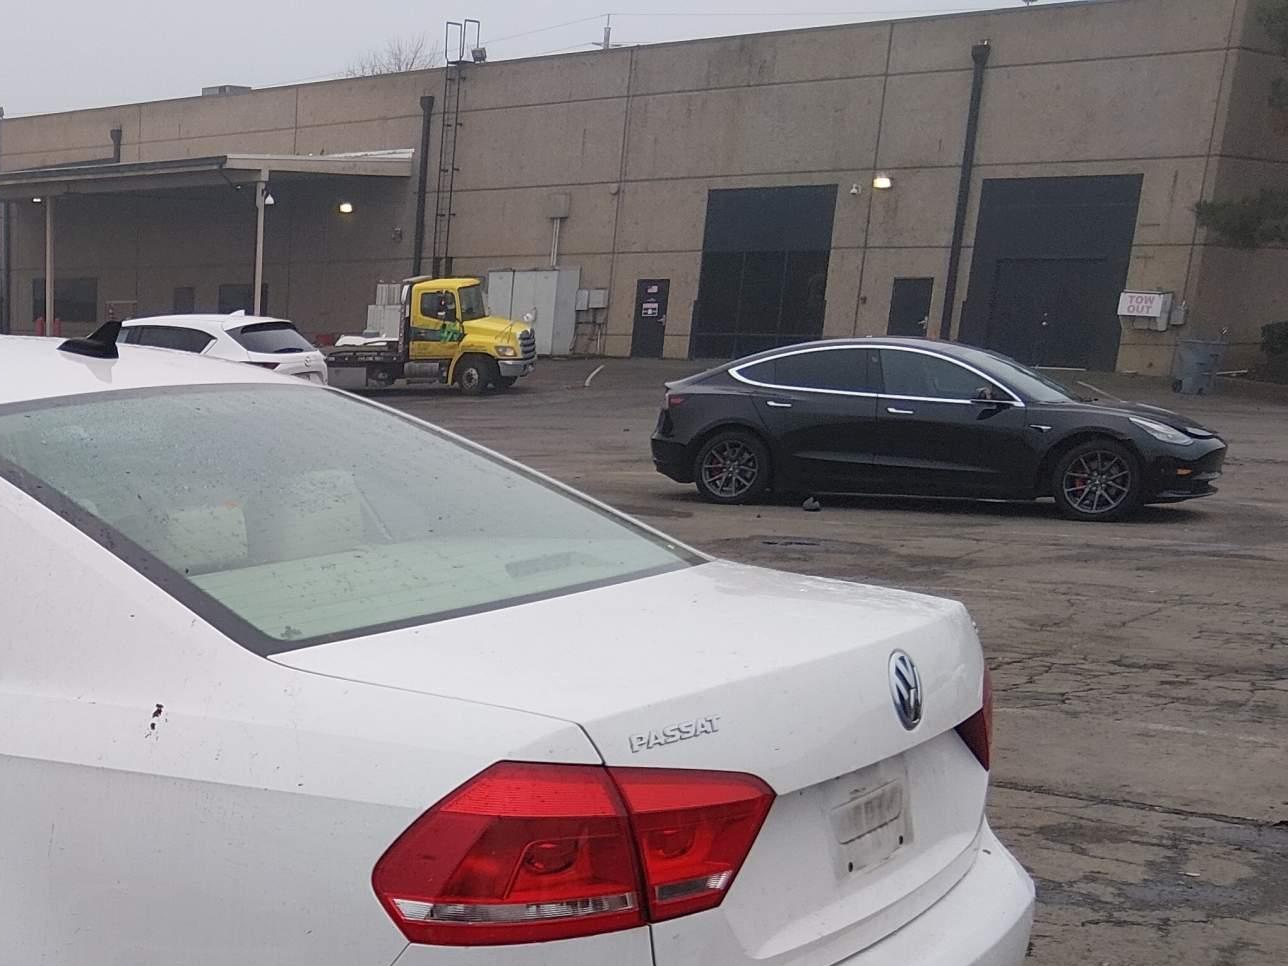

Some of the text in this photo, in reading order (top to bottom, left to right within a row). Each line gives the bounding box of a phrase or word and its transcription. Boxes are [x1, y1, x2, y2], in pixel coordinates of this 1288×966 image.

[1128, 295, 1155, 304] TOW
[1127, 304, 1153, 314] OUT
[629, 715, 720, 753] PASSAT
